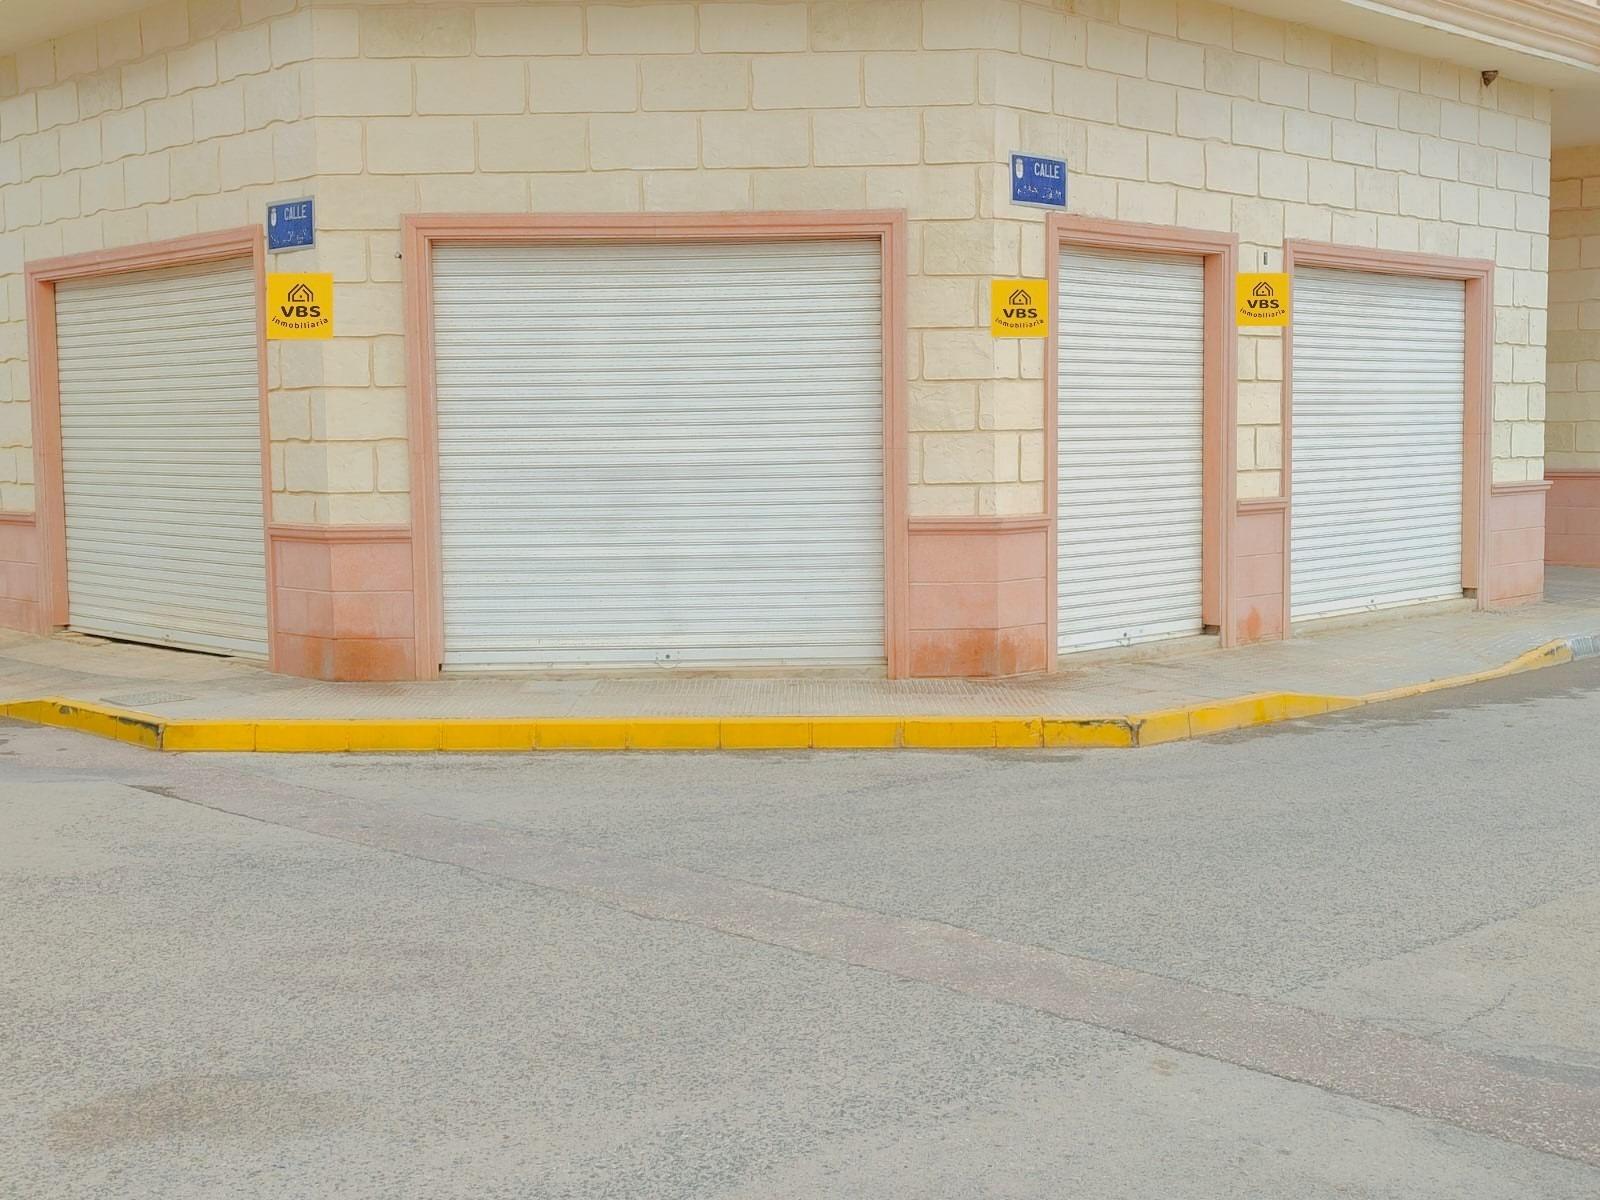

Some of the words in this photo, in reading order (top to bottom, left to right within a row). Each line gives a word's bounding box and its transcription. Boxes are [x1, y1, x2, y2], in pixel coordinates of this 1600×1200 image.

[1034, 162, 1060, 179] CALLE
[284, 204, 307, 221] CALLE
[1247, 299, 1280, 309] VBS
[280, 305, 321, 318] VBS
[1002, 308, 1038, 318] VBS
[1240, 307, 1286, 318] inmobiliaria
[271, 315, 329, 329] inmobiliaria
[994, 317, 1045, 328] inmobiliaria
